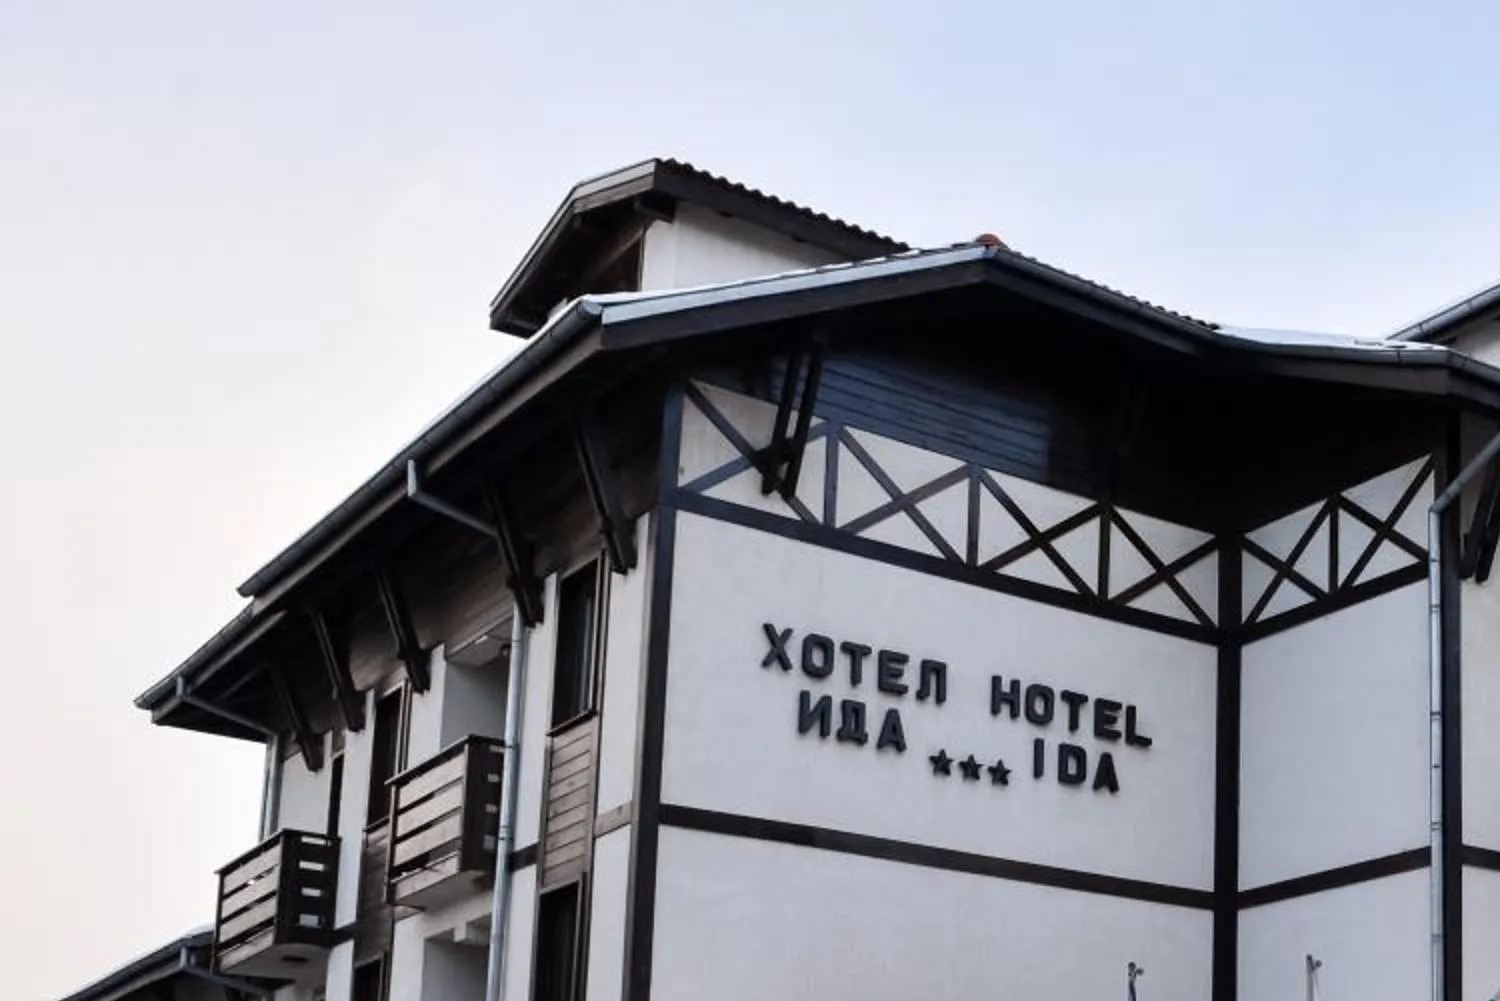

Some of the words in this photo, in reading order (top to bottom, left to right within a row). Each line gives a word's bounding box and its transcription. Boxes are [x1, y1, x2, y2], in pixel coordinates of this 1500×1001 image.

[760, 622, 948, 706] ХОТЕЛ
[797, 690, 908, 755] ИДА
[990, 674, 1154, 750] HOTEL
[1032, 737, 1121, 795] IDA
